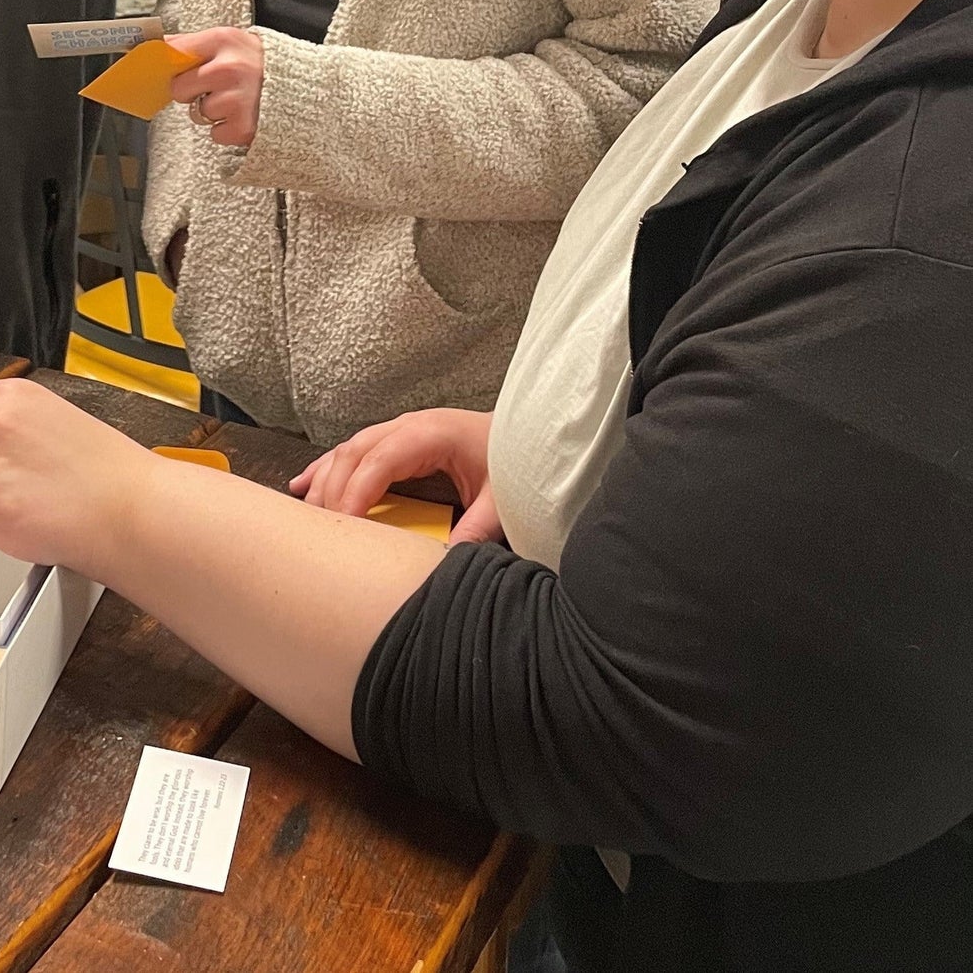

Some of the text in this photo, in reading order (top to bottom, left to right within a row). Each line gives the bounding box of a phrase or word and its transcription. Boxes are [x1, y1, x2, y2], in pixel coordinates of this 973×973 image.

[50, 26, 143, 40] SECOND
[154, 837, 165, 850] They
[138, 850, 150, 863] They
